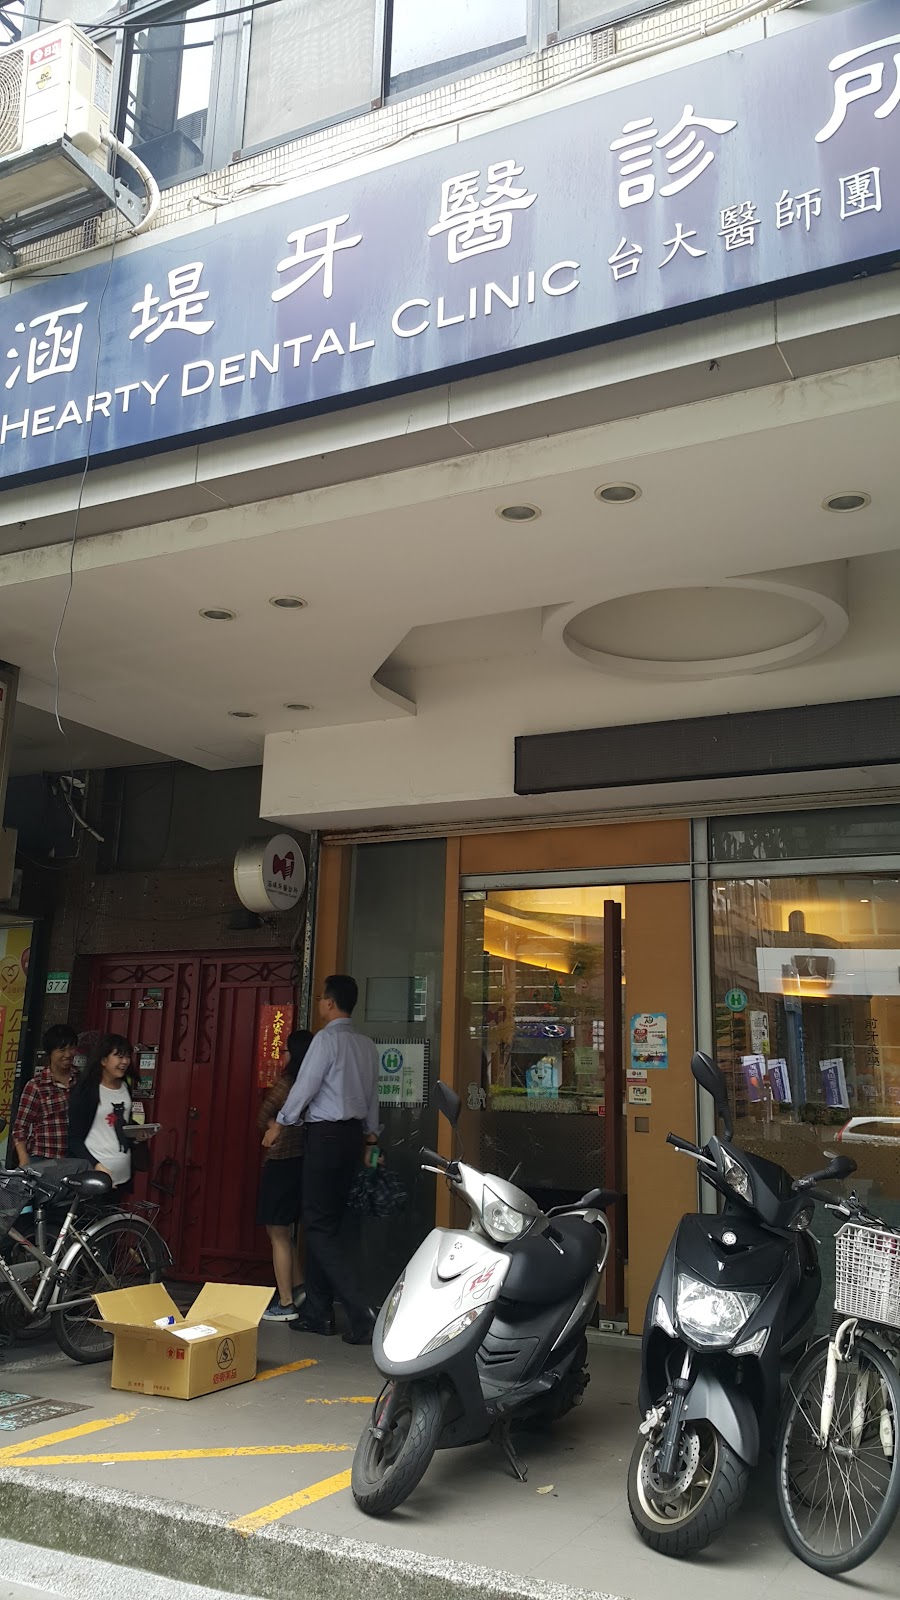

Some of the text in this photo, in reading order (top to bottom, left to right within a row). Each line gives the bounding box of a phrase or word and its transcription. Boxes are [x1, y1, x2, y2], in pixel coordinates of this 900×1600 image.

[608, 166, 882, 281] 台大醫師團
[0, 260, 580, 444] HEARTY DENTAL CLINIC
[47, 981, 68, 992] 377
[865, 1018, 880, 1077] 前牙美學
